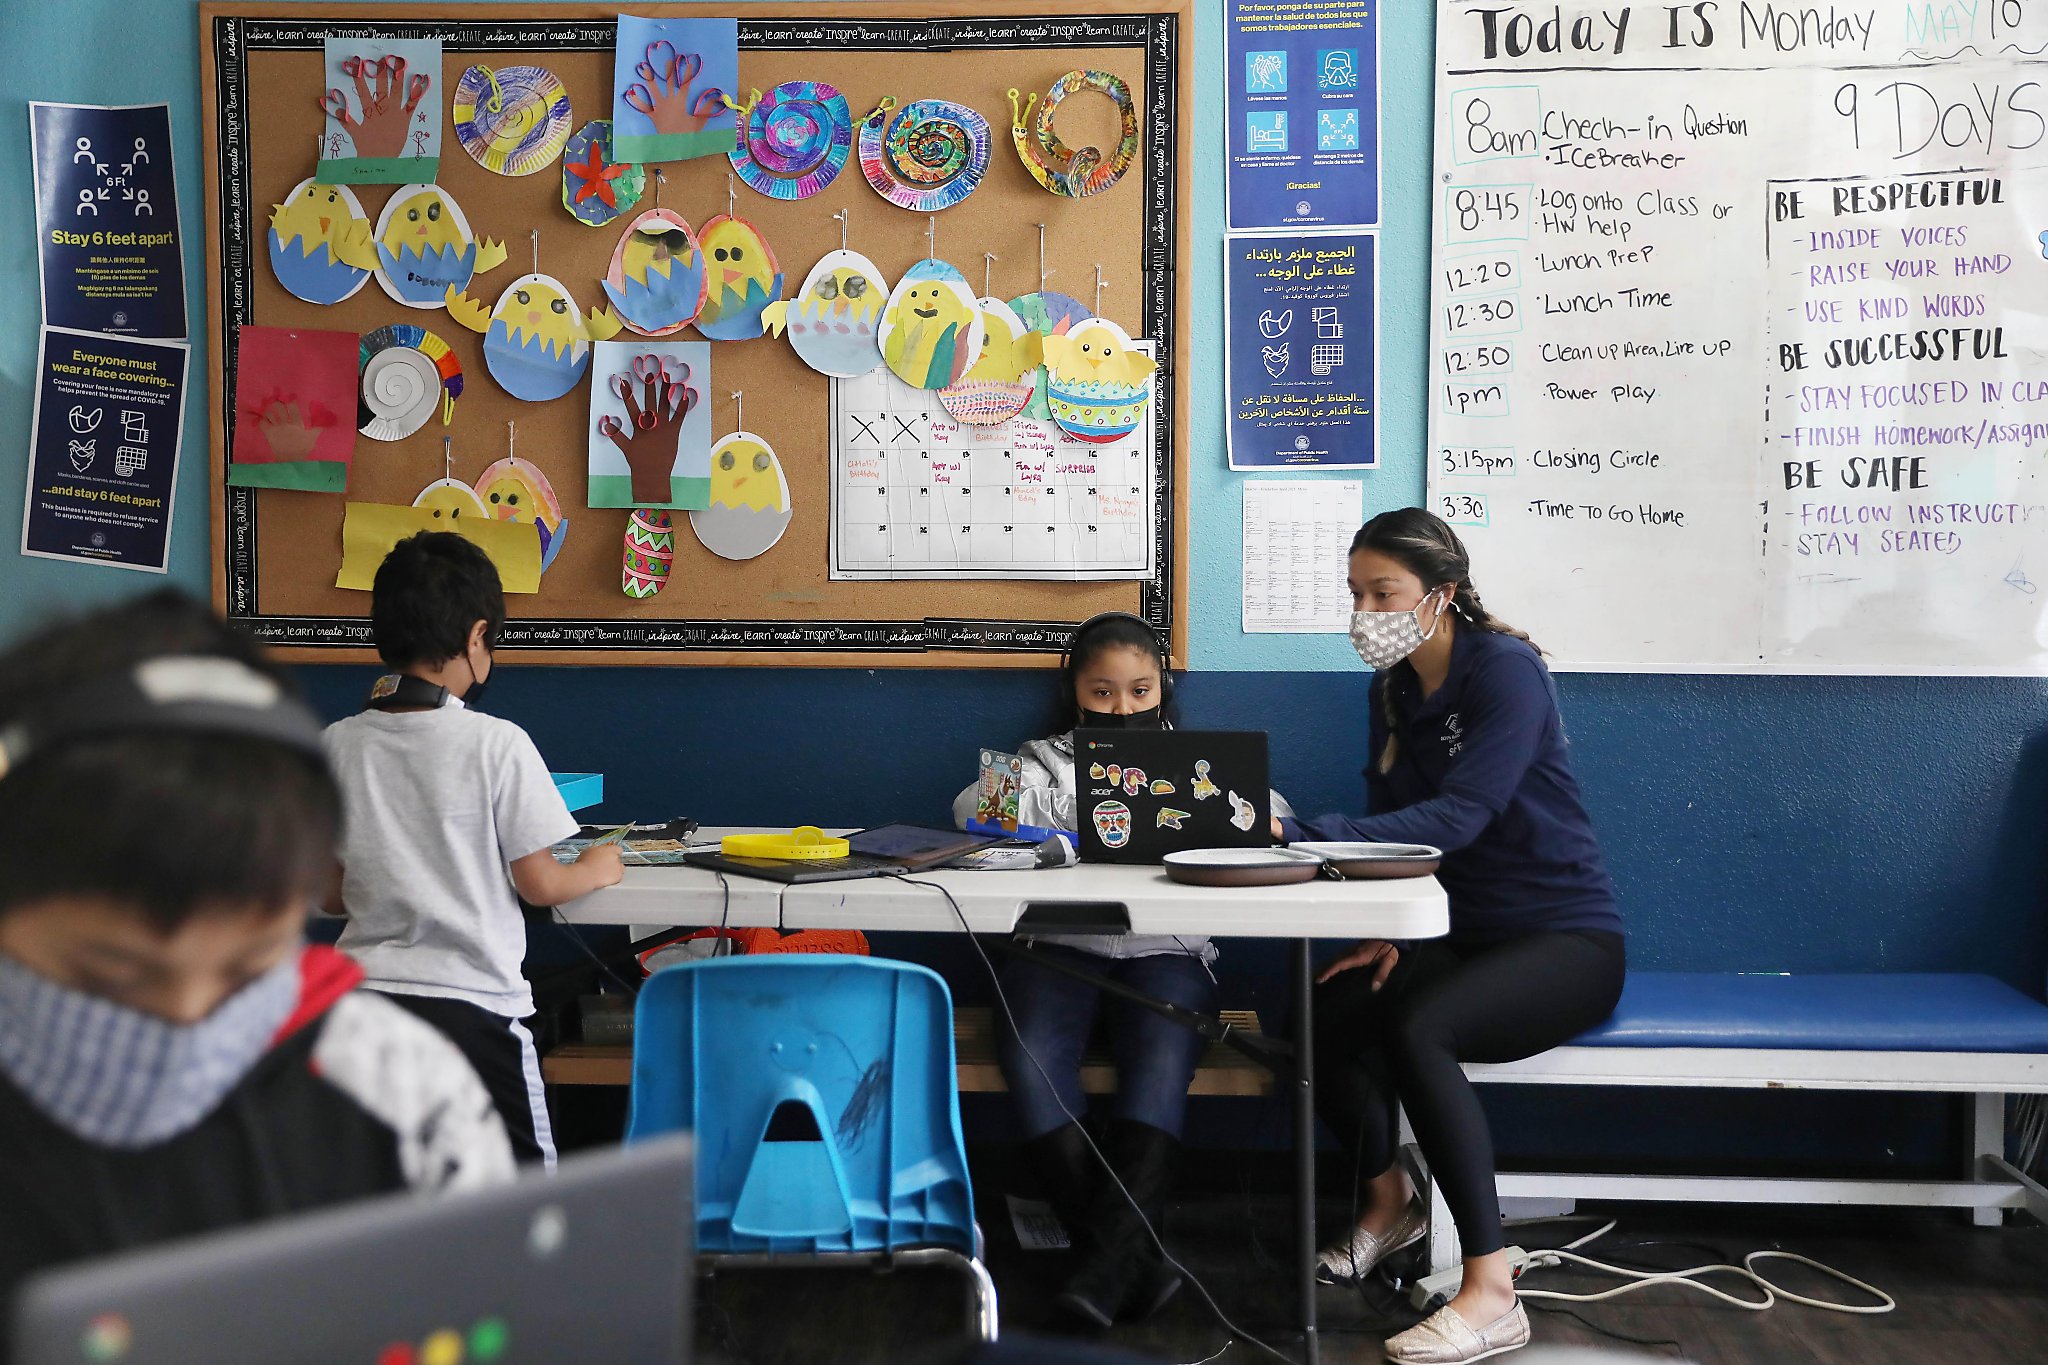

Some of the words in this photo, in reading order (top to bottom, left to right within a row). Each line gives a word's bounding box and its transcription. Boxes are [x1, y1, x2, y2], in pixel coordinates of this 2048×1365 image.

[1235, 14, 1274, 23] mantener
[1274, 13, 1282, 21] la
[1282, 12, 1304, 21] salud
[1305, 11, 1315, 20] de
[1316, 11, 1339, 19] todos
[1340, 10, 1352, 18] los
[1353, 10, 1368, 19] que
[1239, 4, 1254, 12] Por
[1254, 3, 1276, 12] favor,
[1277, 3, 1302, 11] ponga
[1324, 1, 1345, 9] parte
[1346, 1, 1365, 9] para
[765, 29, 793, 40] learn
[796, 28, 823, 39] create
[1241, 25, 1267, 33] somos
[1268, 22, 1318, 32] trabajadores
[1319, 21, 1363, 30] esenciales.
[1740, 1, 1875, 51] Monday
[1906, 0, 1978, 45] MAY
[485, 30, 517, 44] inspire
[519, 30, 547, 42] learn
[549, 29, 577, 41] create
[1466, 98, 1537, 155] 8am
[1684, 104, 1748, 138] Question
[1835, 83, 1859, 150] 9
[106, 177, 114, 187] 6
[115, 177, 126, 187] Ft
[1286, 182, 1321, 191] ¡Gracias!
[1583, 191, 1623, 211] onto
[1637, 189, 1699, 217] Class
[1712, 203, 1733, 219] or
[1775, 191, 1805, 222] BE
[1832, 178, 2005, 217] RESPECTFUL
[1455, 190, 1519, 231] 8:45
[51, 229, 90, 248] Stay
[92, 231, 104, 245] 6
[105, 230, 137, 245] feet
[140, 230, 173, 248] apart
[1587, 215, 1632, 242] help
[1901, 226, 1968, 247] VOICES
[1246, 248, 1282, 263] بارتداء
[1286, 247, 1313, 262] ملزم
[1316, 245, 1355, 263] الجميع
[1540, 252, 1602, 273] Lunch
[1303, 265, 1324, 280] على
[1327, 263, 1356, 276] غطاء
[1446, 261, 1512, 292] 12:20
[1810, 263, 1871, 287] RAISE
[1885, 258, 1939, 280] YOUR
[1955, 254, 2012, 276] HAND
[1544, 292, 1613, 315] Lunch
[1618, 288, 1673, 308] Time
[1805, 301, 1843, 322] USE
[1859, 297, 1909, 322] KIND
[1923, 294, 1985, 318] WORDS
[1446, 299, 1514, 331] 12:30
[1542, 343, 1593, 362] Clean
[1779, 343, 1808, 372] BE
[1824, 327, 2008, 368] SUCCESSFUL
[72, 349, 127, 367] Everyone
[128, 359, 157, 371] must
[1445, 346, 1510, 374] 12:50
[52, 363, 81, 375] wear
[83, 368, 90, 376] a
[92, 366, 117, 379] face
[118, 372, 175, 388] covering...
[1242, 396, 1254, 405] عن
[1255, 395, 1271, 405] تقل
[1273, 395, 1280, 403] لا
[1282, 394, 1308, 403] مسافة
[1310, 394, 1325, 405] على
[1446, 385, 1502, 413] 1pm
[1546, 382, 1597, 401] Power
[1800, 385, 1851, 412] STAY
[1861, 380, 1968, 409] FOCUSED
[1981, 381, 2002, 403] IN
[1238, 407, 1268, 420] الآخرين
[1270, 405, 1309, 418] الأشخاص
[1312, 408, 1323, 417] عن
[1326, 404, 1351, 417] أقدام
[1353, 405, 1369, 415] ستة
[1875, 419, 2048, 449] Homework/Assign
[1442, 449, 1513, 474] 3:15pm
[1533, 448, 1600, 473] Closing
[1783, 460, 1823, 490] BE
[1841, 457, 1929, 492] SAFE
[42, 485, 73, 496] ...and
[74, 488, 98, 501] stay
[100, 490, 108, 500] 6
[109, 491, 131, 504] feet
[132, 497, 161, 508] apart
[41, 502, 54, 510] This
[55, 505, 81, 514] business
[87, 509, 112, 518] required
[119, 512, 138, 521] refuse
[138, 515, 159, 524] service
[1531, 500, 1573, 519] Time
[1800, 503, 1892, 526] FOLLOW
[62, 513, 84, 521] anyone
[123, 521, 145, 529] comply.
[1798, 532, 1859, 555] STAY
[504, 629, 531, 639] learn
[534, 629, 561, 640] create
[598, 629, 621, 639] learn
[623, 630, 645, 641] CREATE
[648, 630, 683, 642] inspire
[1090, 788, 1114, 796] acer
